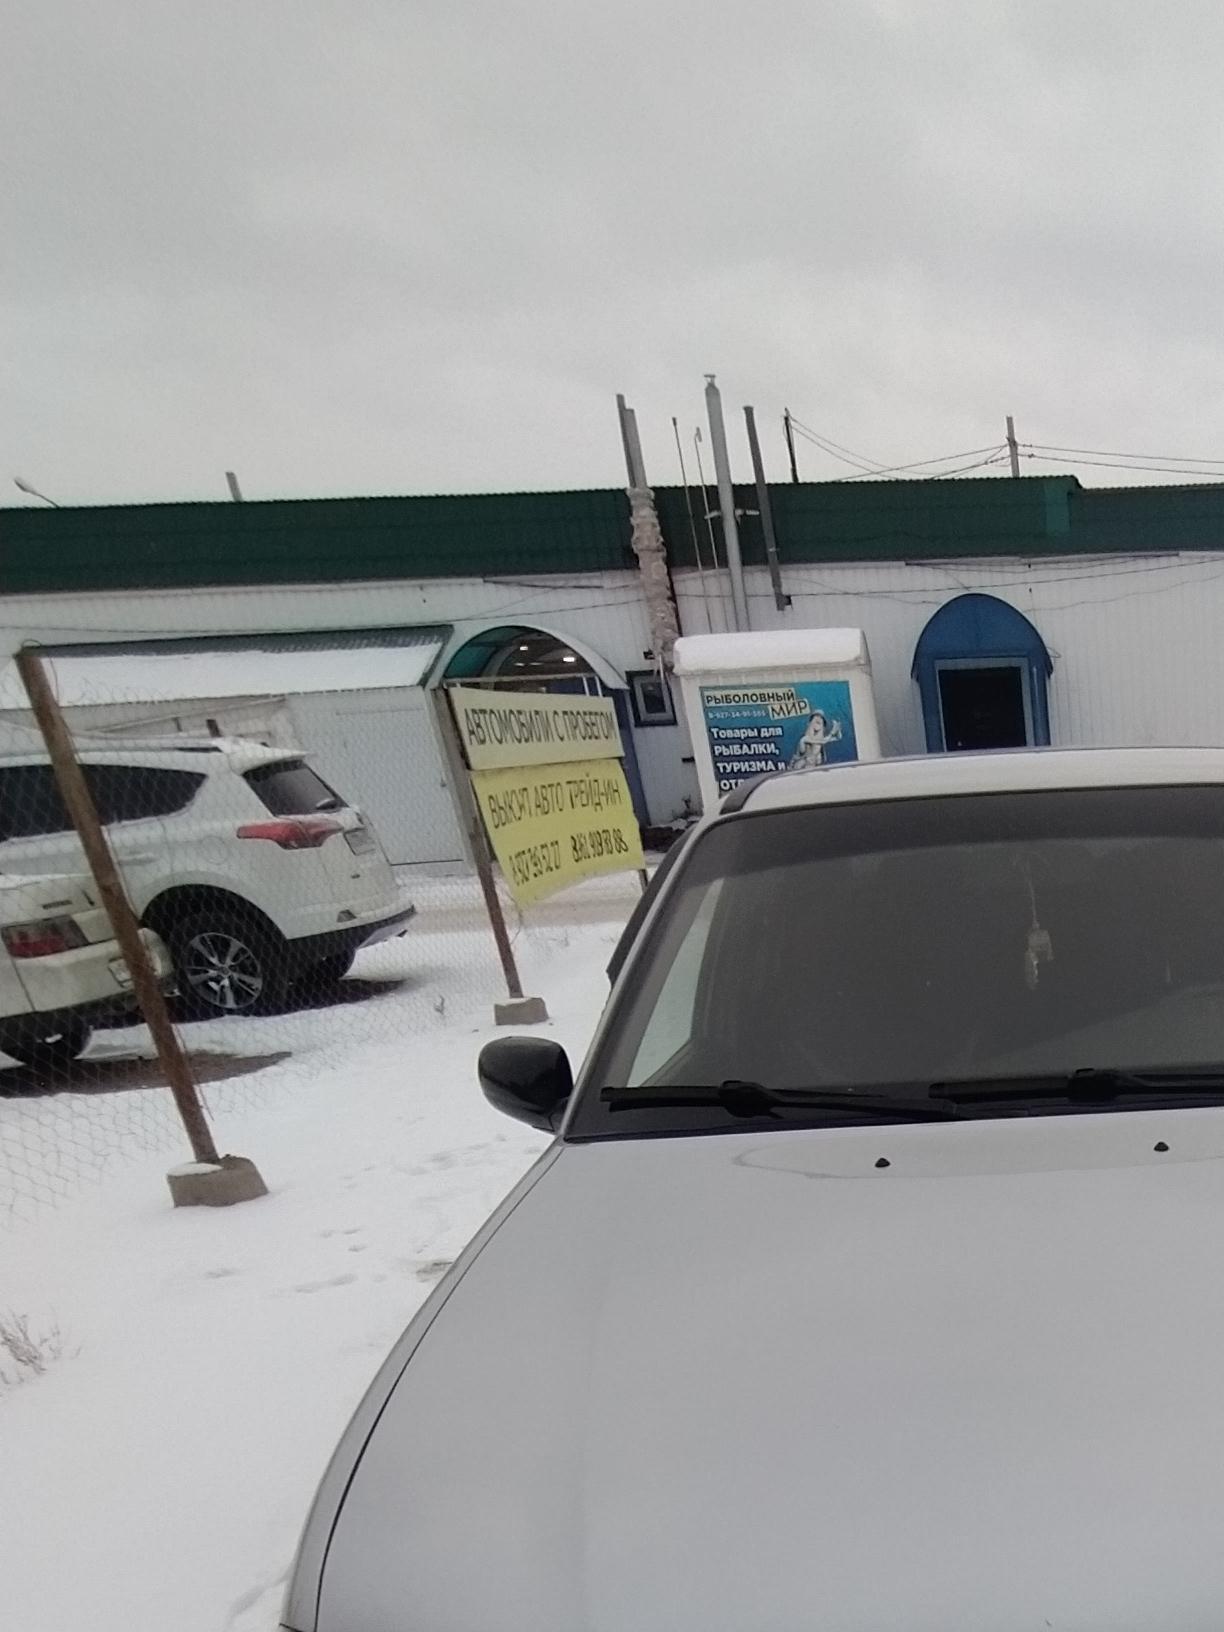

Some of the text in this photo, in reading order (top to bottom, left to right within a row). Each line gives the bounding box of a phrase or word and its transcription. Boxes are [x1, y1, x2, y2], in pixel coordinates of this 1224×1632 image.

[706, 689, 795, 705] РЫБОЛОВНЫЙ
[771, 700, 808, 718] МИР
[464, 708, 619, 745] АВТОМОБИЛИ С ПРОБЕГОМ
[711, 727, 783, 739] Товары для
[714, 744, 780, 756] РЫБАЛКИ,
[717, 760, 776, 774] ТУРИЗМА
[488, 773, 623, 830] ВЫКУП АВТО ТРЕЙД-ИН
